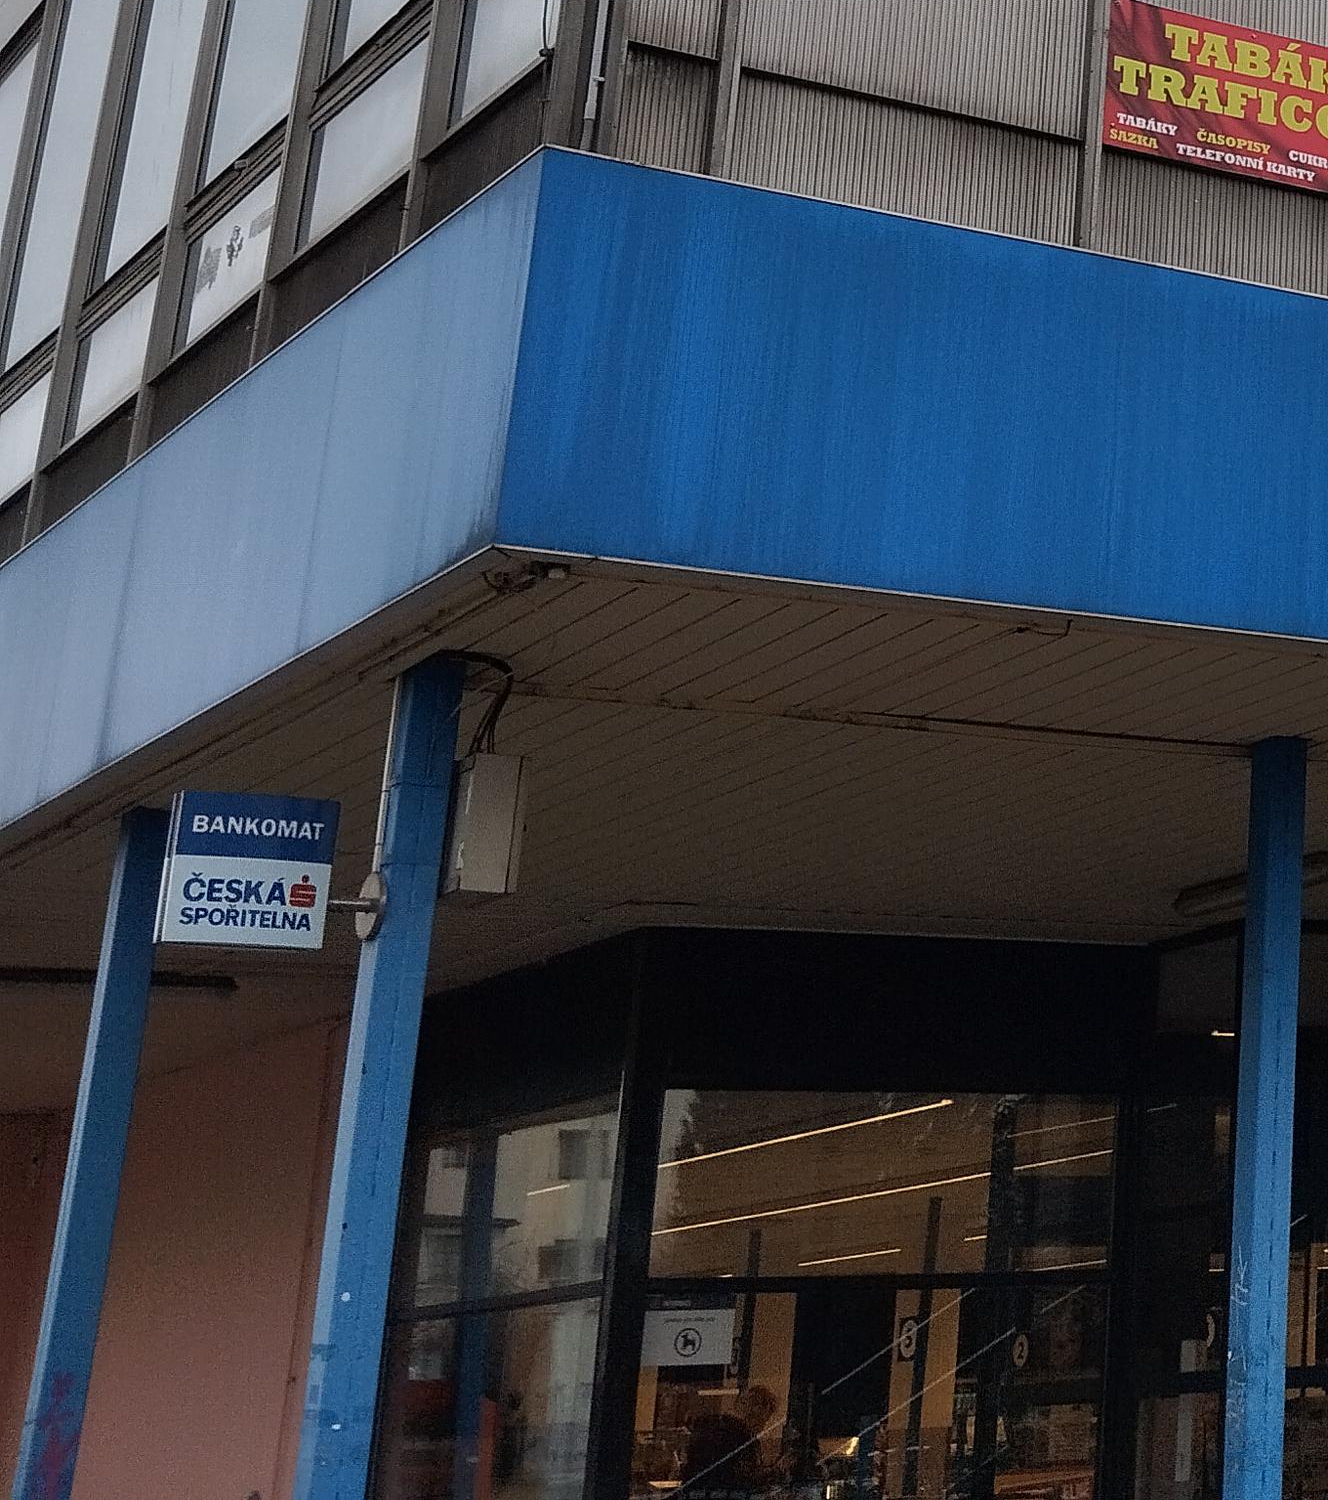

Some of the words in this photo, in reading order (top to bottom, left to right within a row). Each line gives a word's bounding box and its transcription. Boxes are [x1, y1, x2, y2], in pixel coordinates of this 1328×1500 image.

[1116, 112, 1179, 136] TABÁKY
[1196, 127, 1271, 156] ČASOPISY
[1109, 128, 1158, 150] SAZKA
[1176, 143, 1264, 171] TELEFONNÍ
[1266, 161, 1316, 182] KARTY
[192, 815, 325, 841] BANKOMAT
[183, 872, 287, 906] ČESKÁ
[179, 904, 311, 932] SPOŘITELNA
